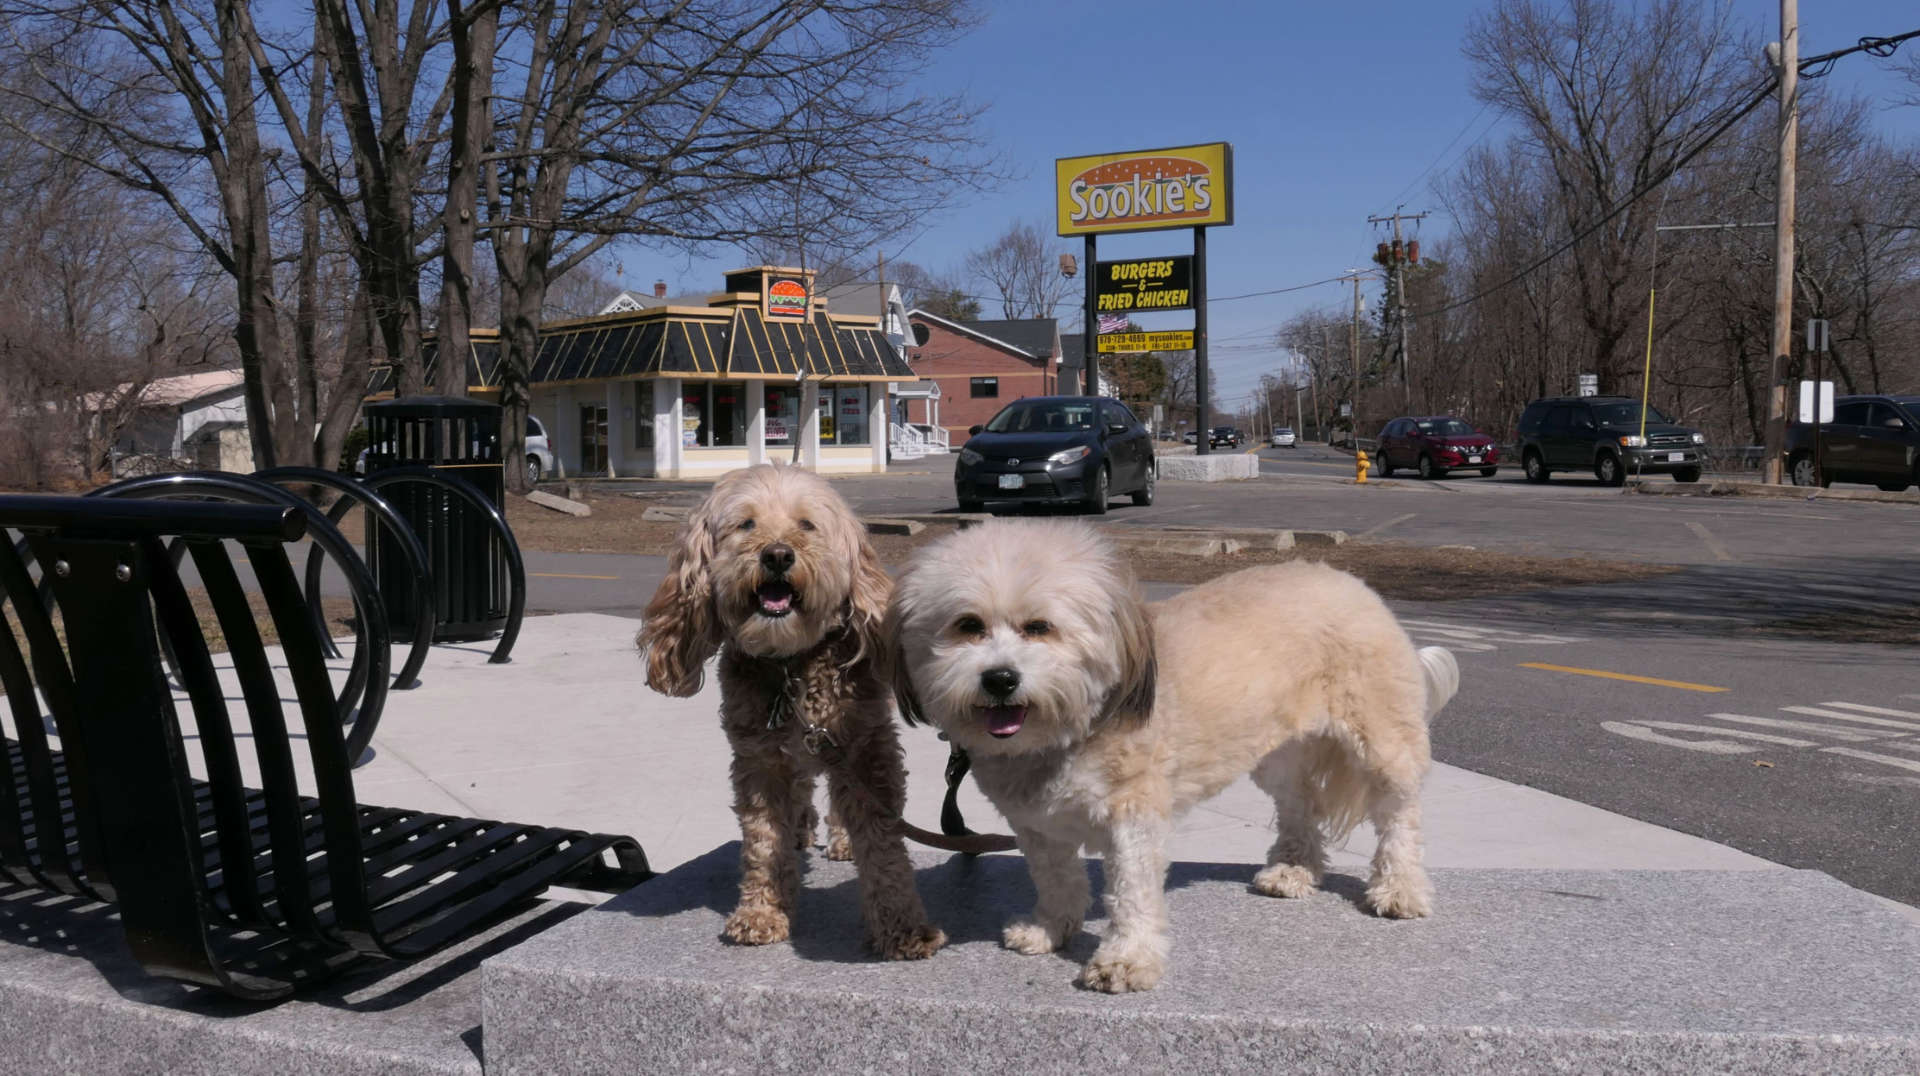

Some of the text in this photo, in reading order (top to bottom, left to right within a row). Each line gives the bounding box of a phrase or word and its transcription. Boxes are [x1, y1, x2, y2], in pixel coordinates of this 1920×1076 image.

[1070, 172, 1210, 221] Sookie's
[1111, 260, 1174, 281] BURGERS
[1138, 279, 1147, 291] &
[1098, 289, 1189, 310] FRIED CHICKEN
